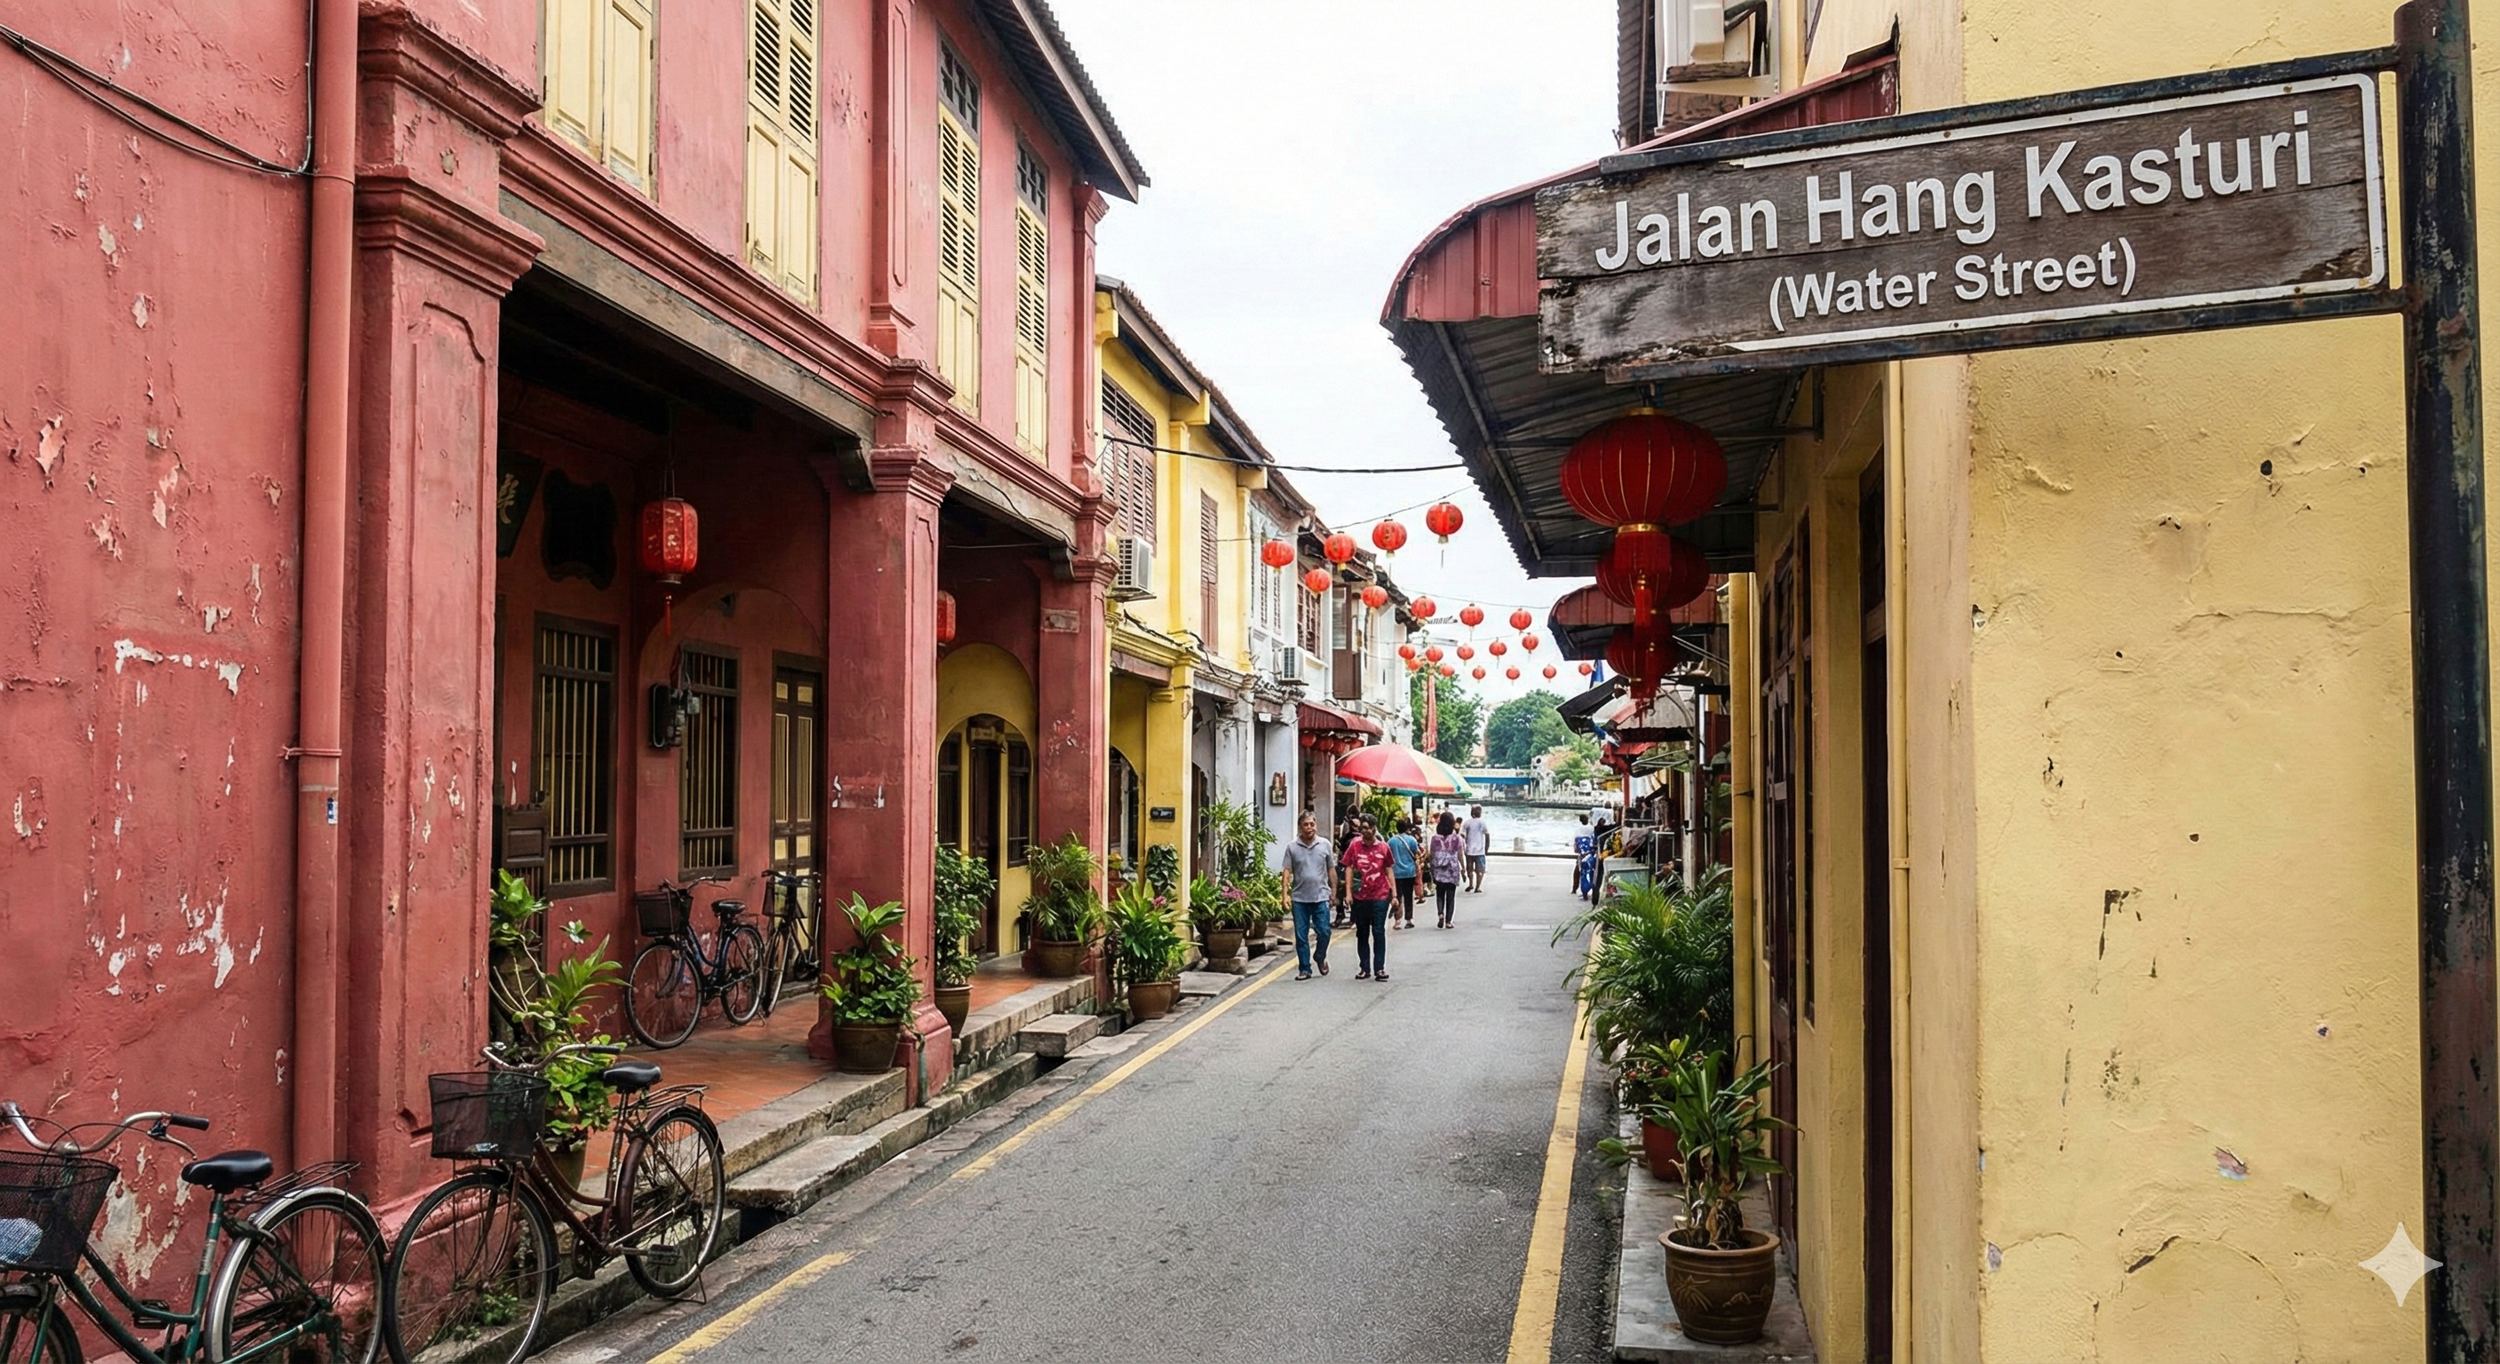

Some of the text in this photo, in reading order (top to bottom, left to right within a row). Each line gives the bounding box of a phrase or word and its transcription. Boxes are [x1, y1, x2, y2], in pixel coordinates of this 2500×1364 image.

[1594, 109, 2313, 271] Jalan Hang Kasturi
[1769, 237, 2137, 333] (Water Street)
